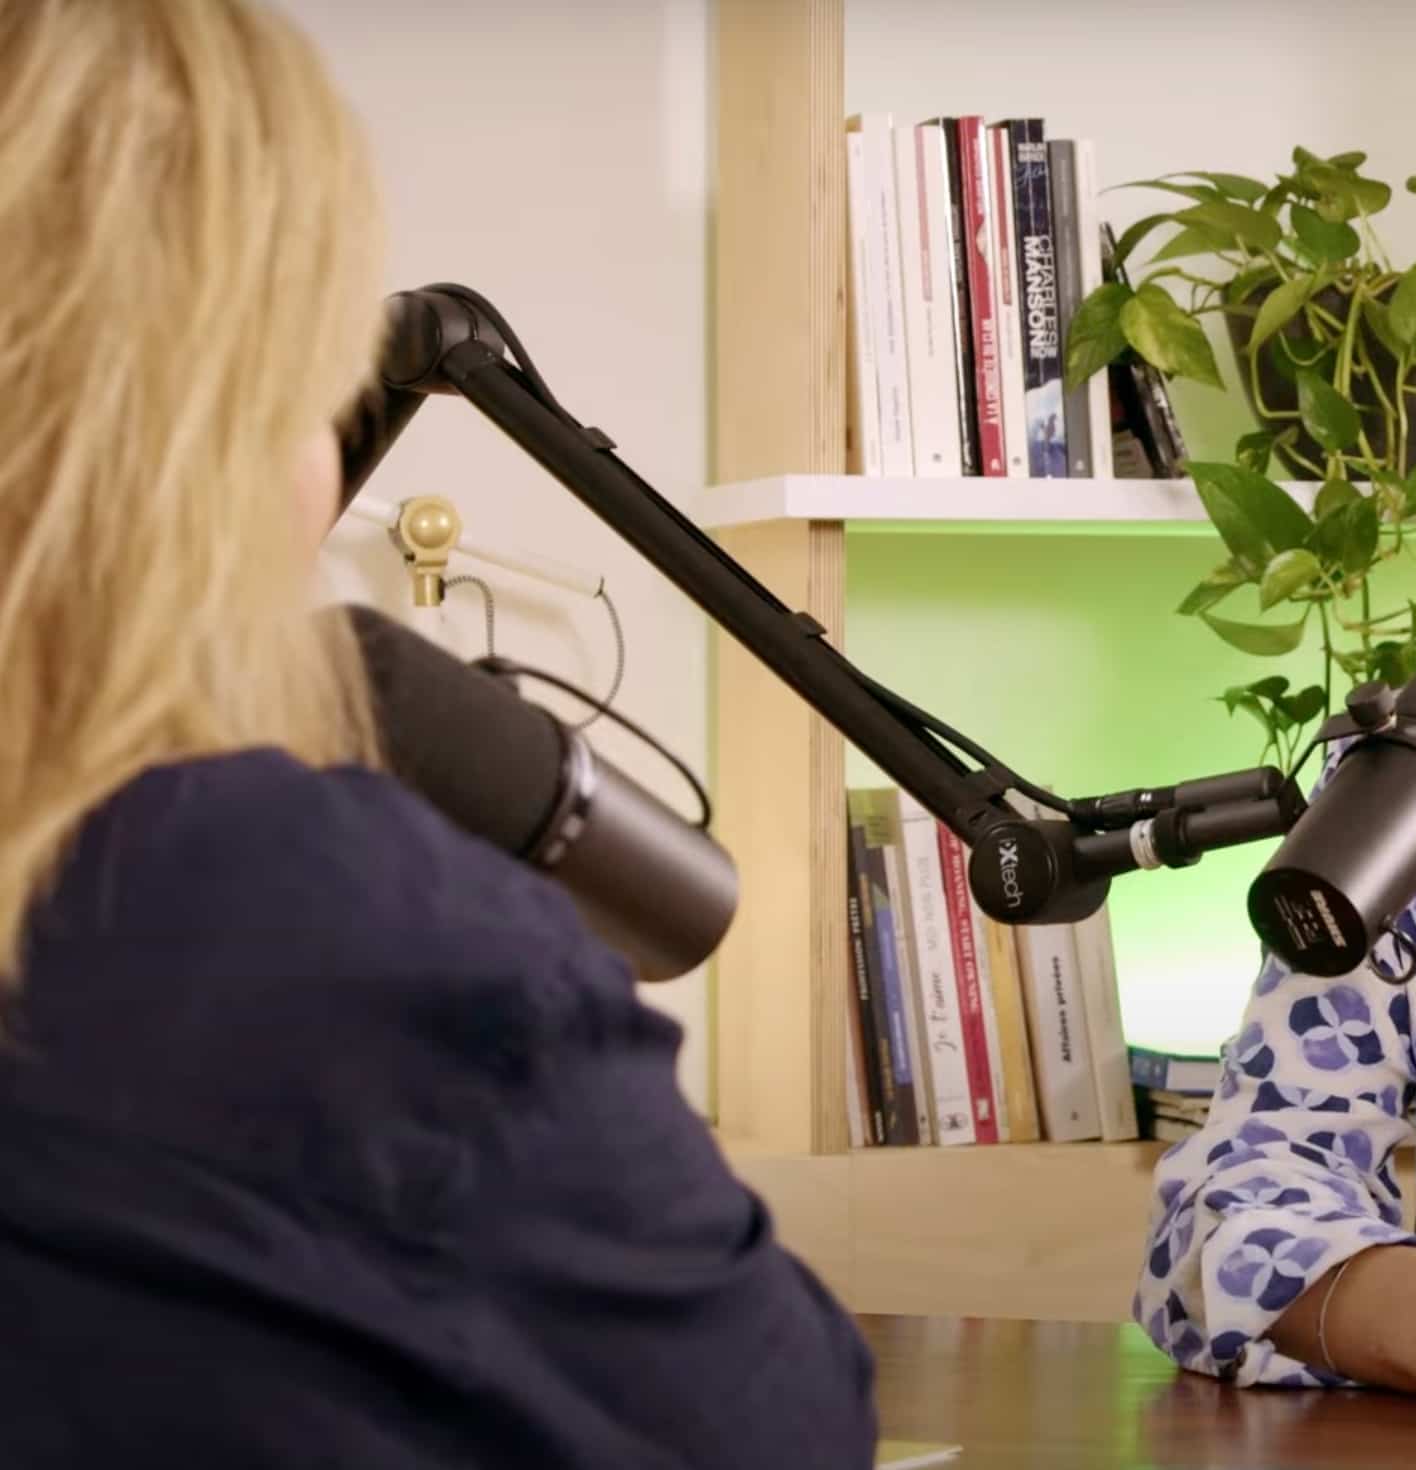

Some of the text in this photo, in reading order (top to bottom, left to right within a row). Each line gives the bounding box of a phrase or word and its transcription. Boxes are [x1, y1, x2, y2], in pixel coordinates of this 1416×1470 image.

[1023, 235, 1045, 347] MANSON
[1039, 234, 1058, 346] CHARLES
[1059, 1008, 1073, 1063] Affaires
